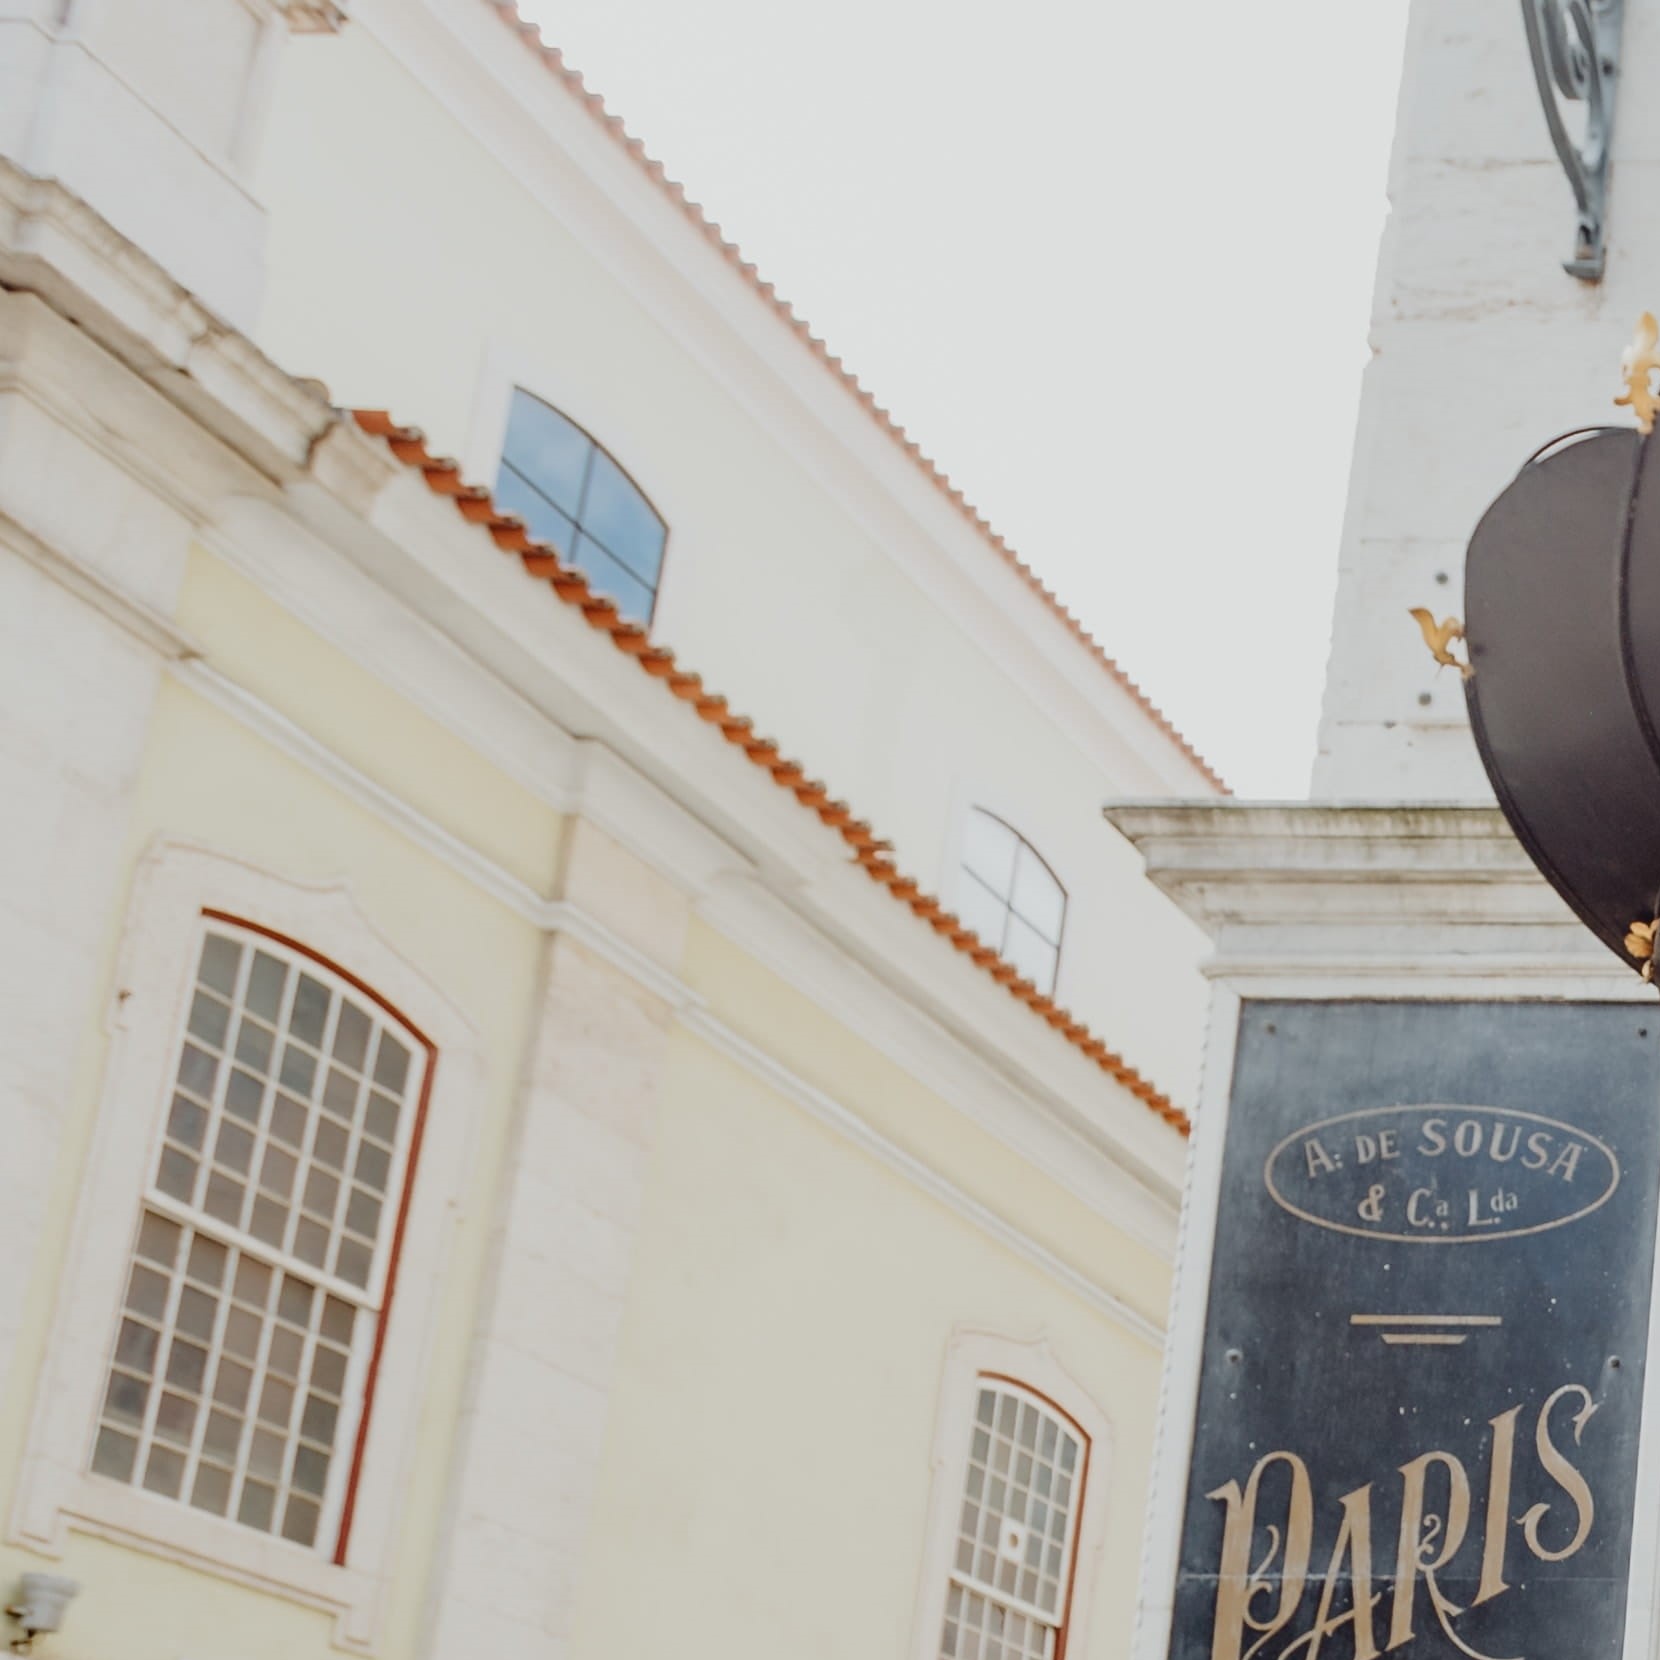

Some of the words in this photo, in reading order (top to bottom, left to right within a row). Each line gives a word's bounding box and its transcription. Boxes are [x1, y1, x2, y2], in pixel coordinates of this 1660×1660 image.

[1355, 1129, 1401, 1165] DE
[1417, 1118, 1589, 1183] SOUSA
[1357, 1183, 1386, 1223] &
